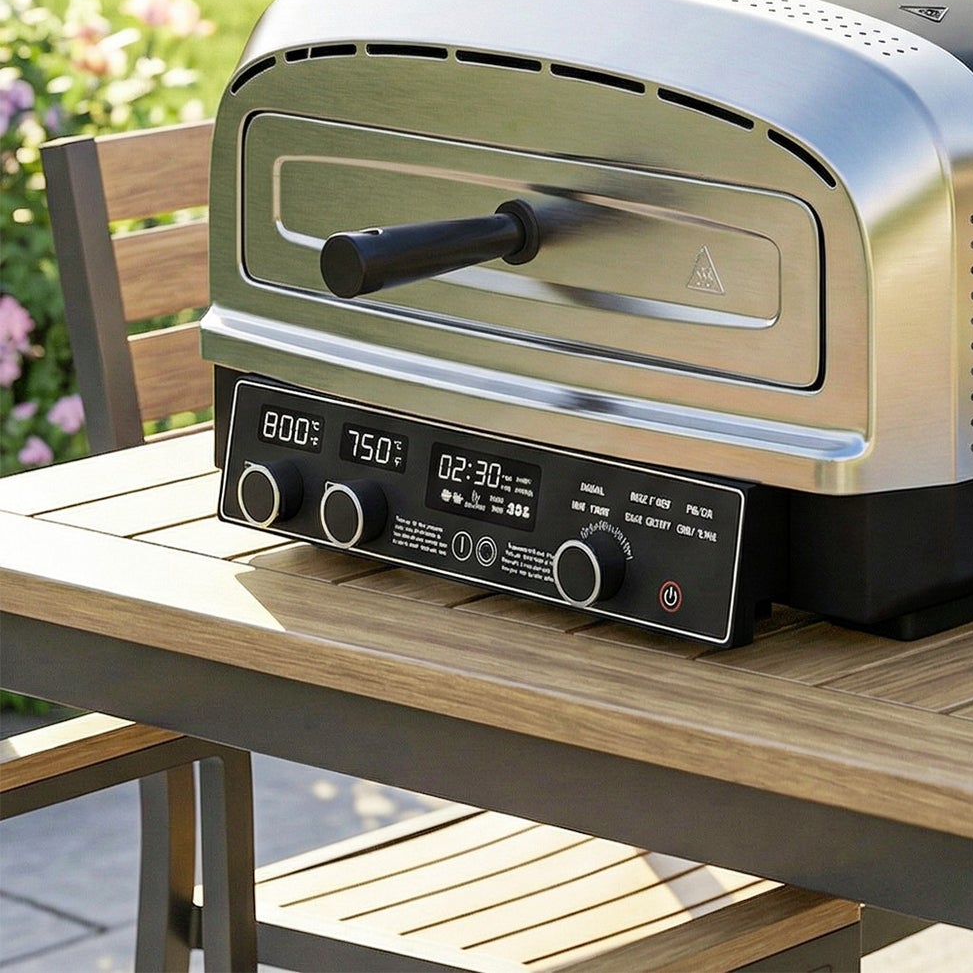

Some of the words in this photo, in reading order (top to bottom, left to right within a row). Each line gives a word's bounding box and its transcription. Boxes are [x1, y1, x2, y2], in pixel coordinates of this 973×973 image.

[262, 411, 310, 446] 800
[348, 429, 392, 464] 750
[438, 454, 502, 488] 02:30
